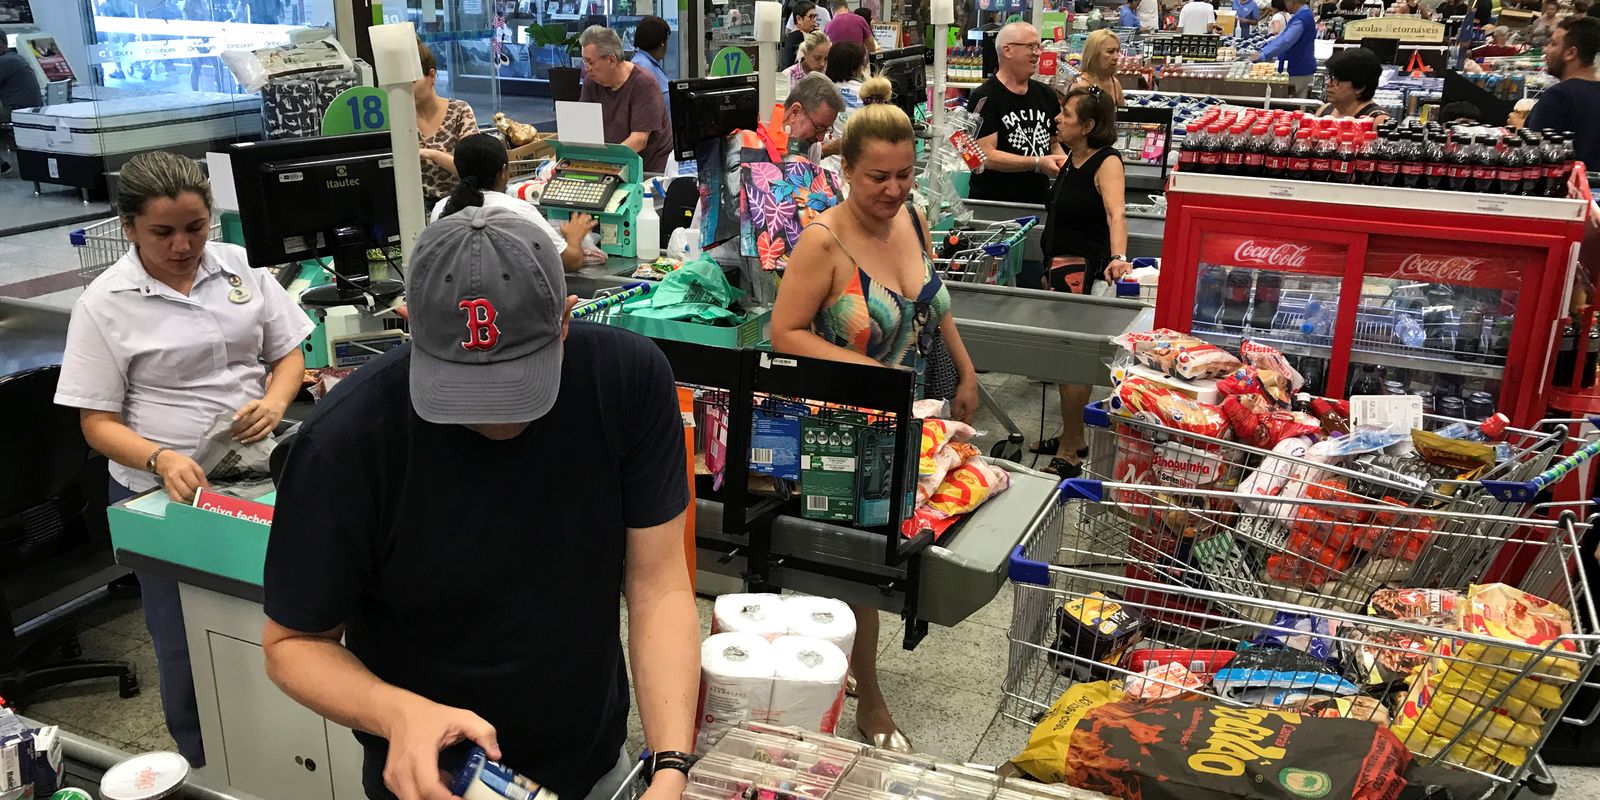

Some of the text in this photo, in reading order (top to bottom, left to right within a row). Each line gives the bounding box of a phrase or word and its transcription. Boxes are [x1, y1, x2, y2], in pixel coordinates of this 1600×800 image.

[1353, 24, 1383, 33] acolas
[724, 52, 741, 75] 17
[347, 95, 385, 129] 18
[325, 177, 360, 190] Itautec
[1234, 240, 1311, 268] Coca-Cola
[1400, 253, 1488, 282] Coca-Cola
[459, 298, 501, 351] B
[1152, 453, 1210, 475] Binaguinha
[236, 510, 273, 527] fecha
